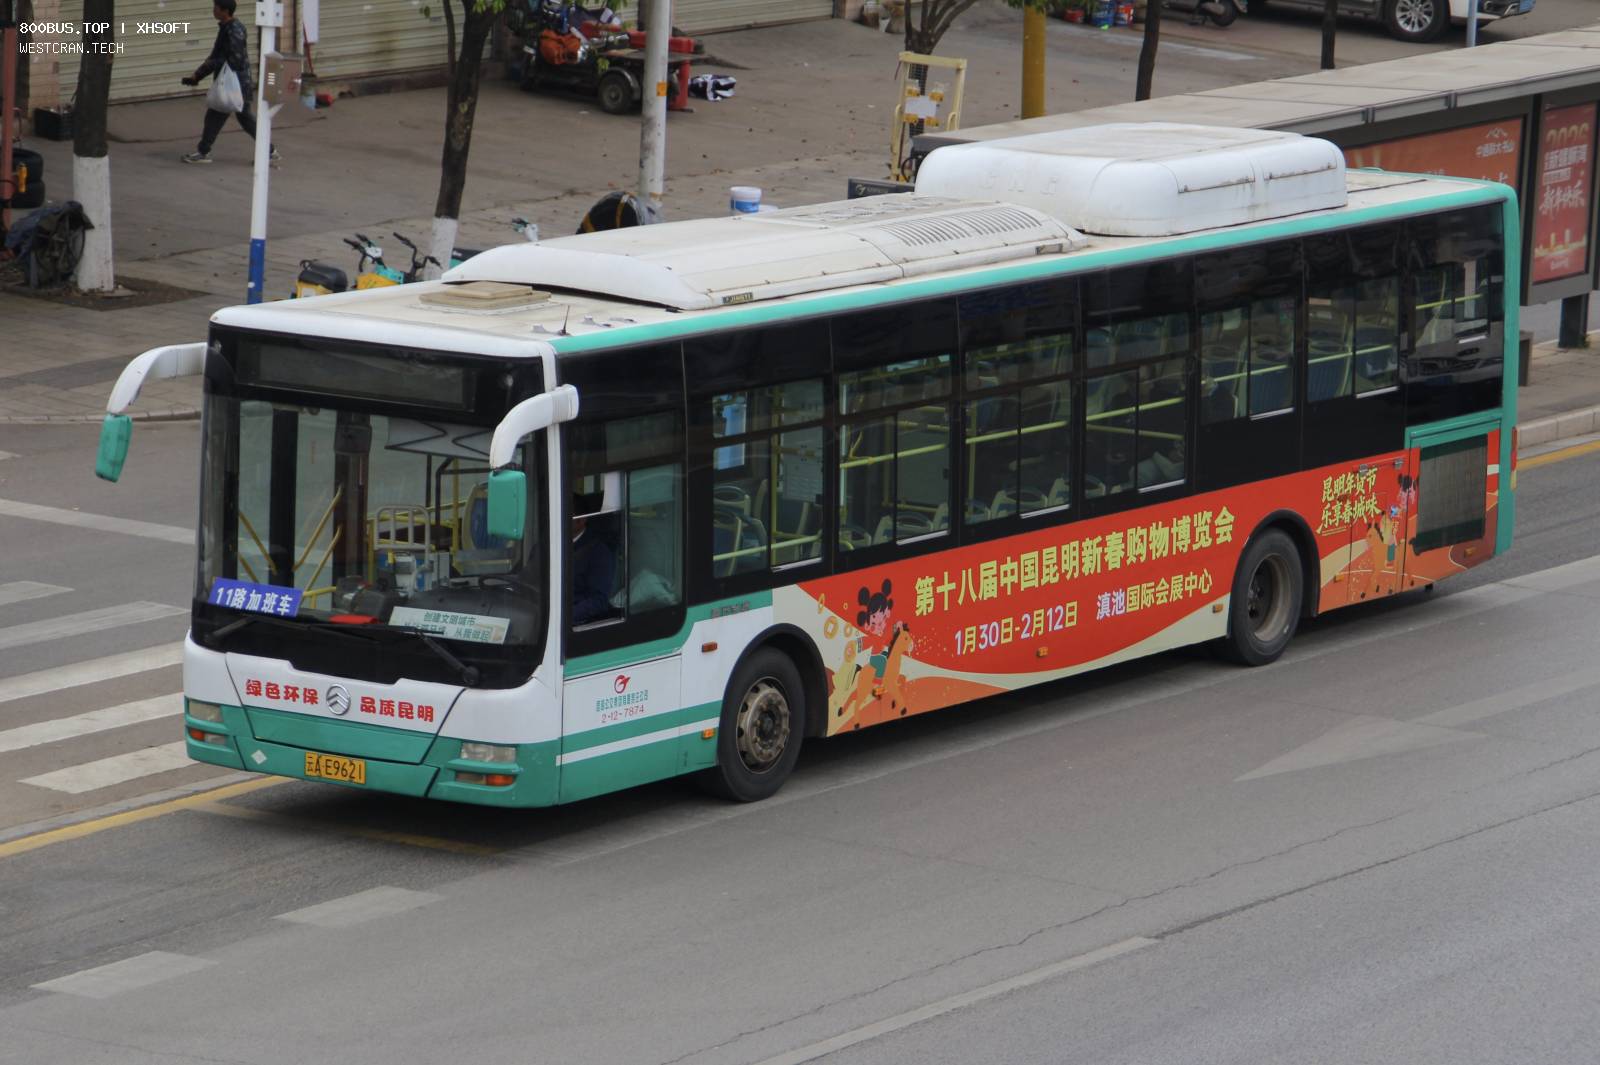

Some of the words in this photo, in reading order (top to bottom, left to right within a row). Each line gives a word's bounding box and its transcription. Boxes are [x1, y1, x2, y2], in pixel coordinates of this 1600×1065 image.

[914, 506, 1236, 617] 第十八届中国昆明新春购物博览会
[216, 586, 293, 616] 11路加班车
[1096, 568, 1213, 621] 滇池国际会展中心
[424, 611, 477, 626] 创建文明城市
[245, 679, 319, 705] 绿色环保
[360, 696, 434, 723] 品质昆明
[601, 704, 645, 723] 2-12-7874
